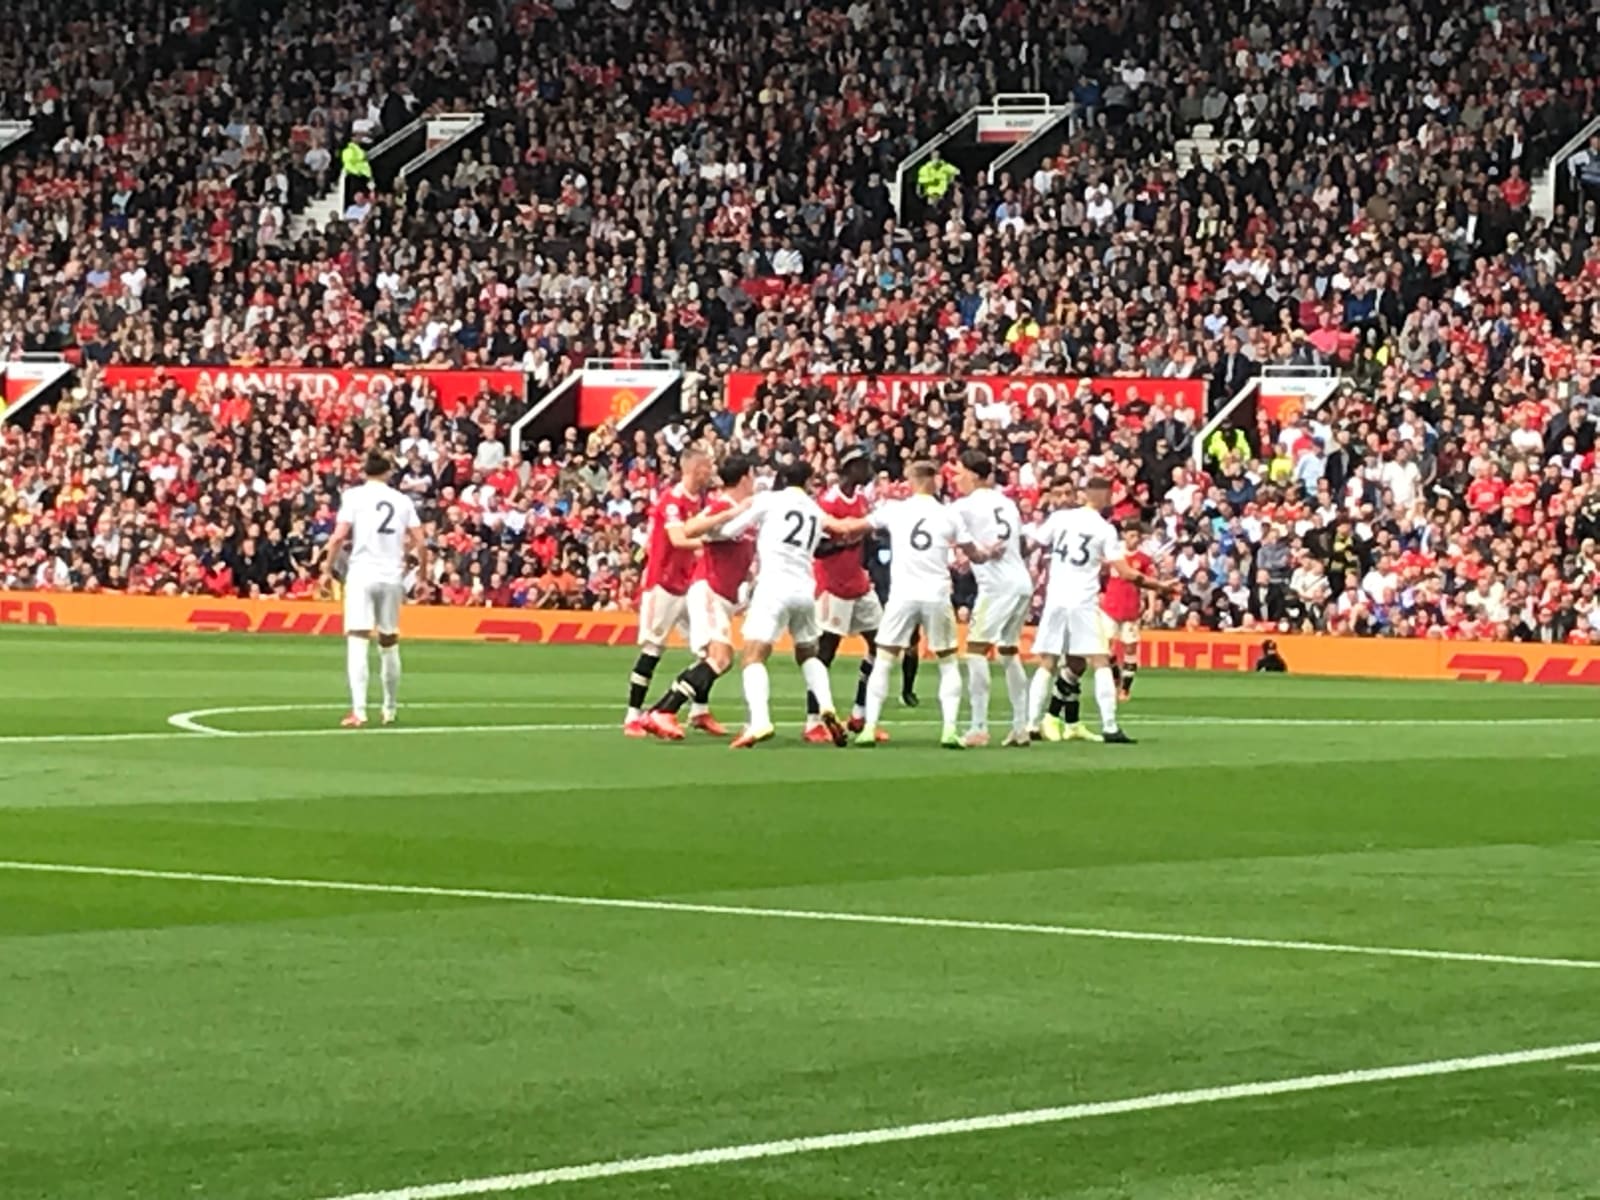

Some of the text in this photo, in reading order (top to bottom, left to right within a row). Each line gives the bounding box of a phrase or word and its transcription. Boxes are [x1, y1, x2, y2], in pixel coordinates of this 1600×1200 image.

[376, 500, 396, 534] 2
[782, 509, 817, 551] 21
[993, 507, 1012, 541] 5
[909, 518, 932, 551] 6
[1053, 529, 1093, 566] 43
